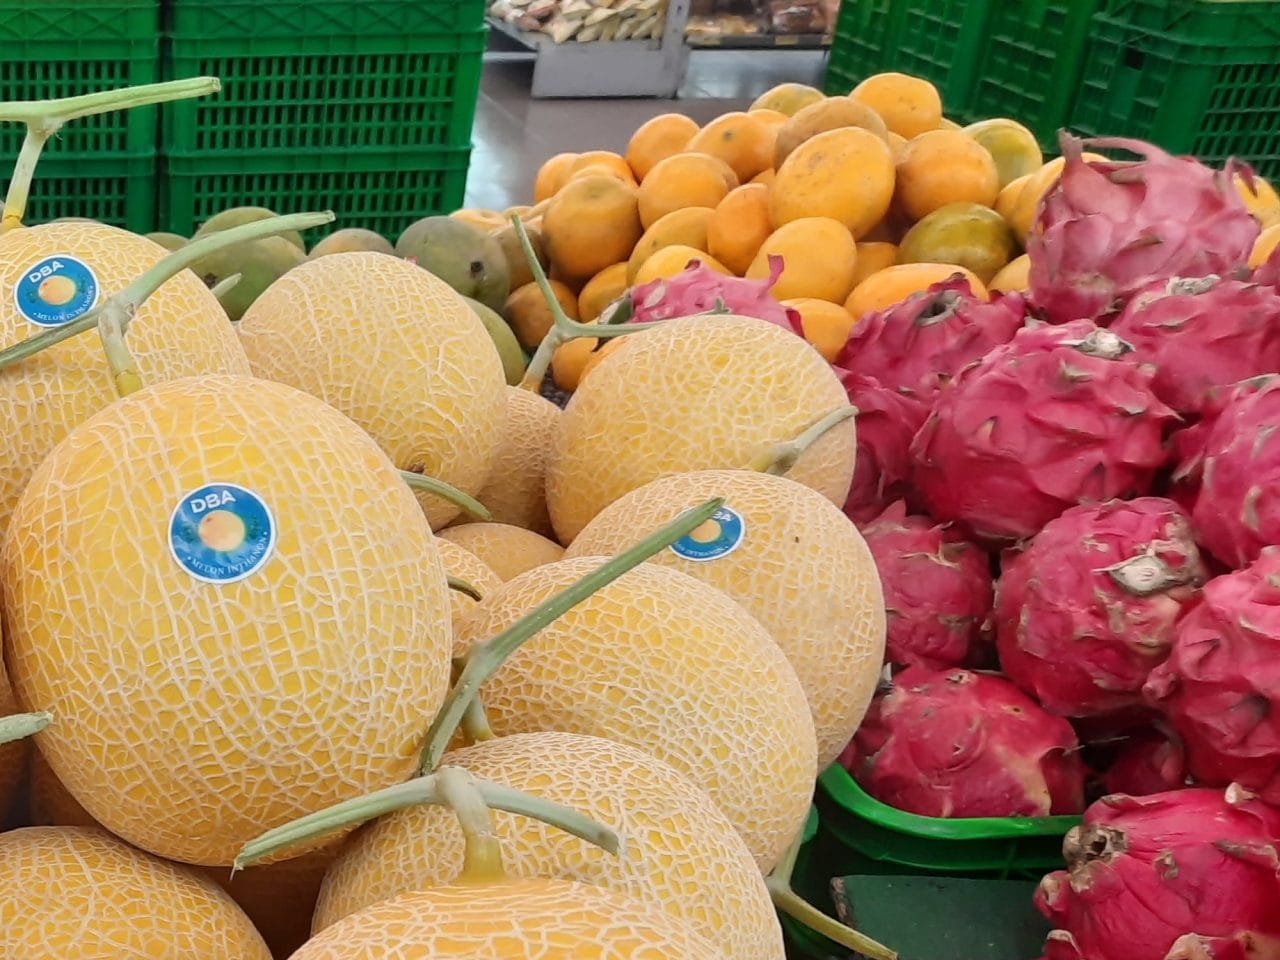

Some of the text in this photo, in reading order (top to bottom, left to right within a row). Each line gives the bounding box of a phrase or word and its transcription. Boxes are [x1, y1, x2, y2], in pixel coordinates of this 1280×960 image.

[29, 261, 64, 283] DBA
[36, 313, 65, 321] MELON
[190, 489, 236, 514] DBA
[191, 558, 225, 575] MELON
